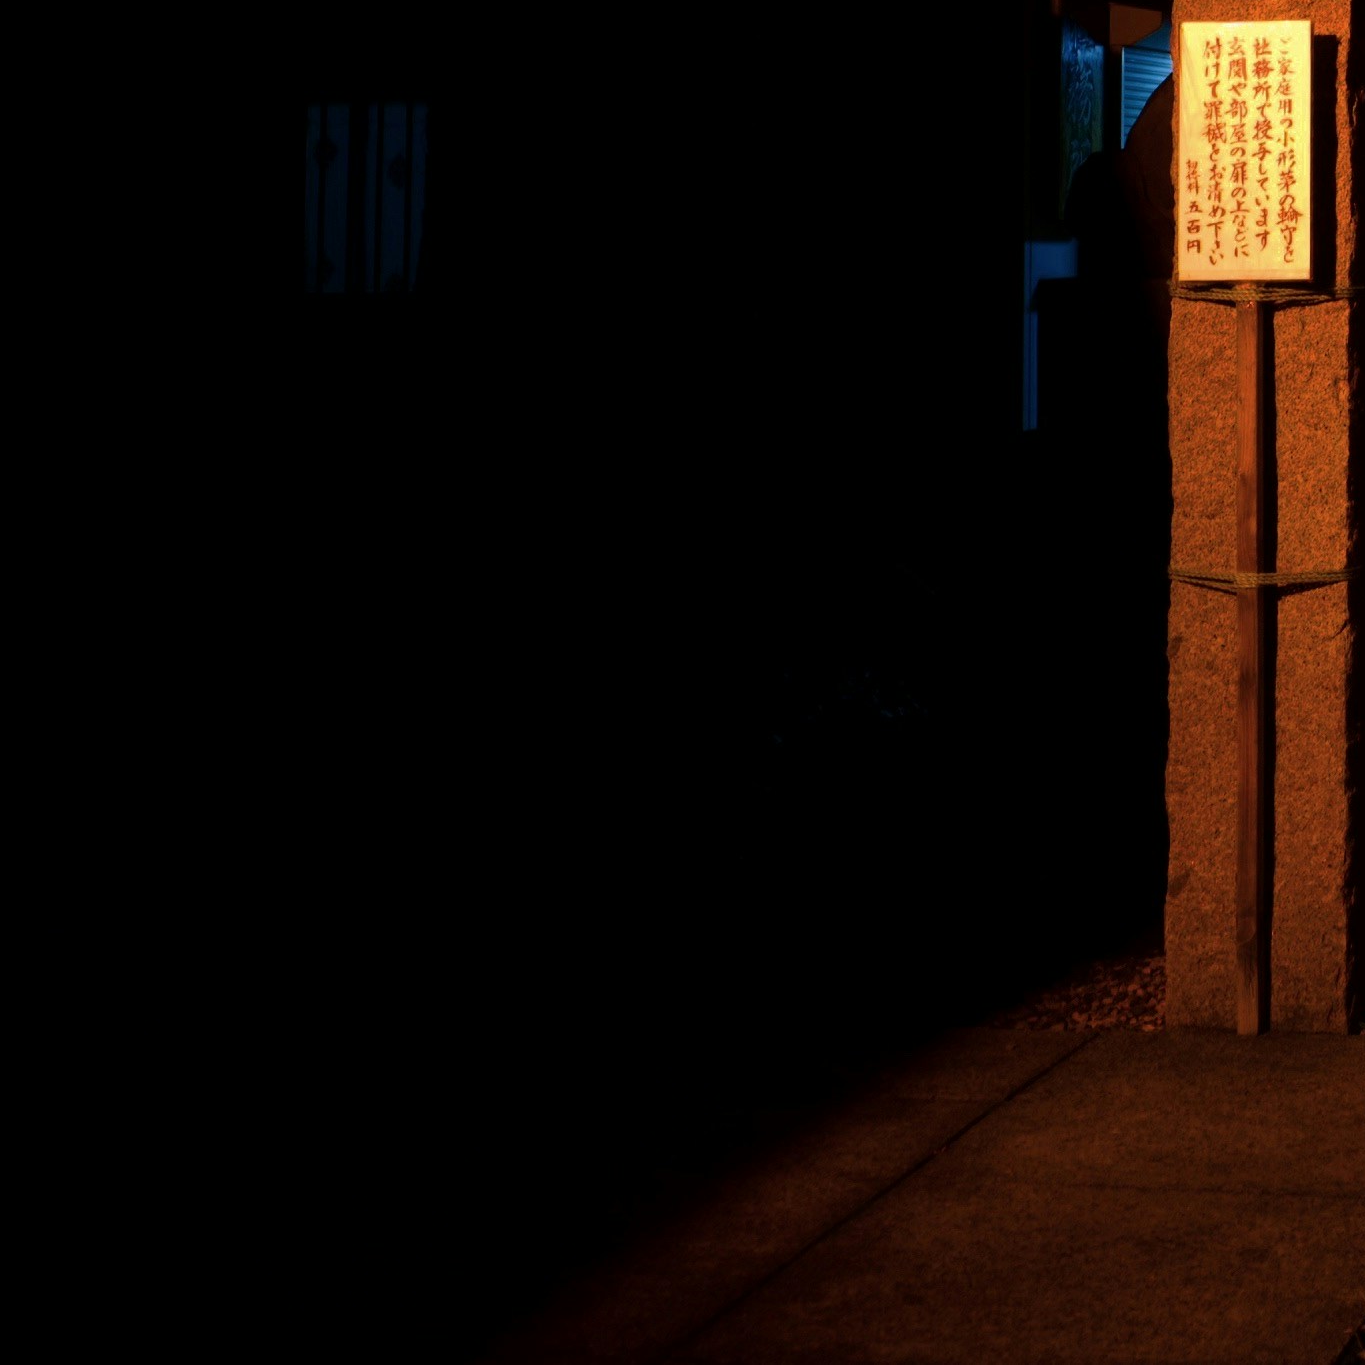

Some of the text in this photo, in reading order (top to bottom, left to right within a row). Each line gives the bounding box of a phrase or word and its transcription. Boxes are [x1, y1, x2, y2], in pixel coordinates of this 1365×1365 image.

[1225, 36, 1250, 258] 玄関や部屋の扉の上などに
[1252, 37, 1274, 253] 社務所で授与しています
